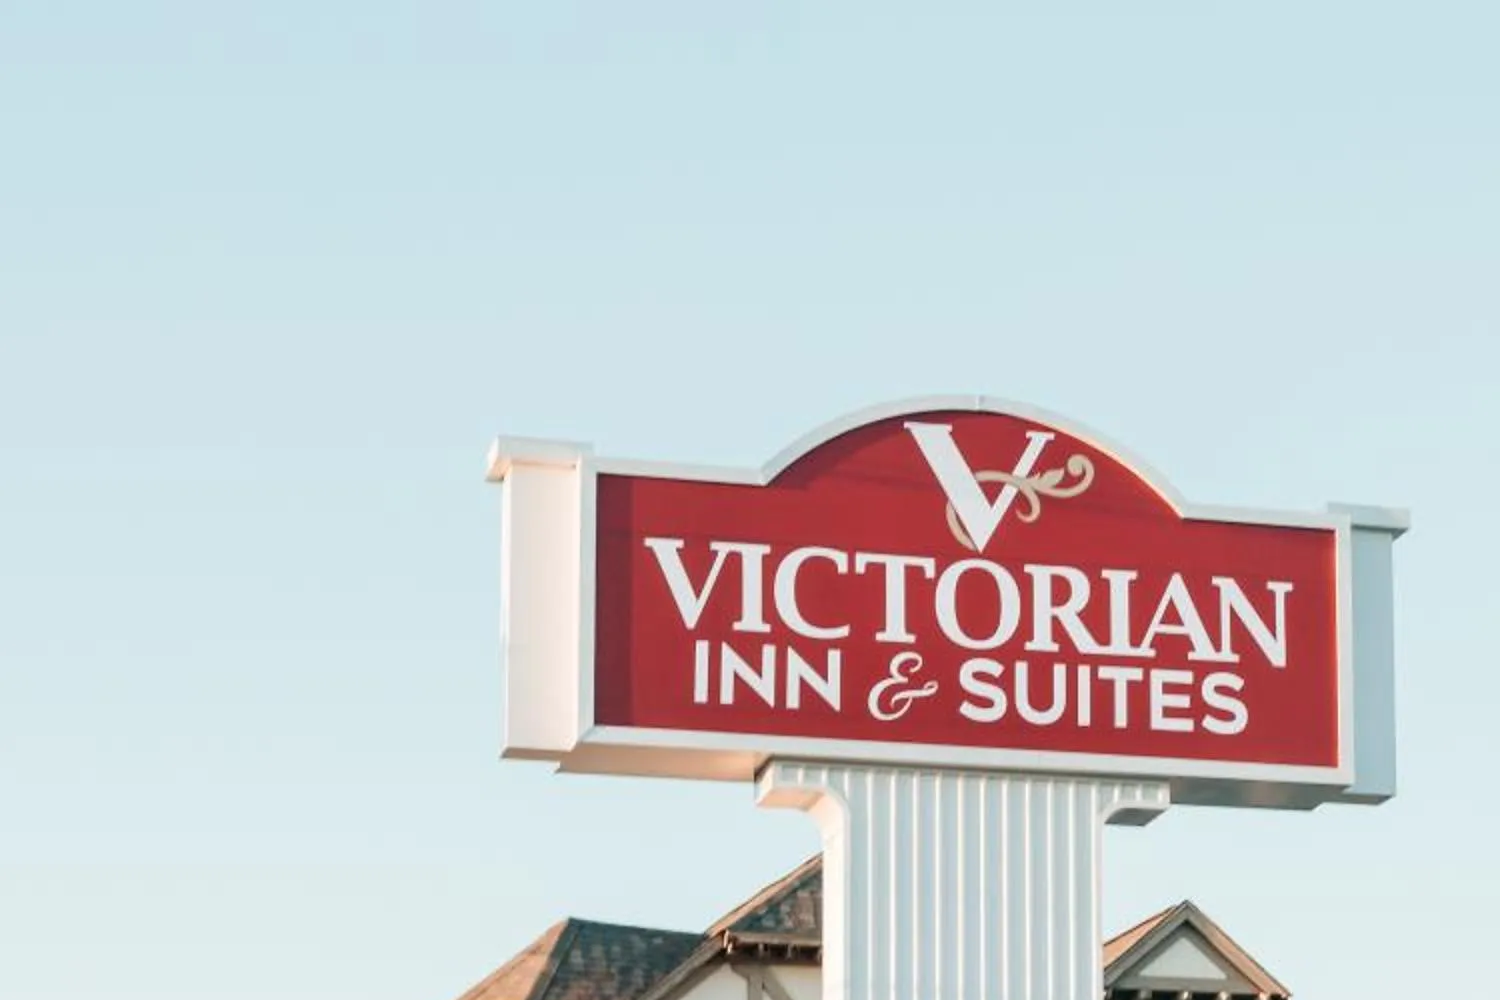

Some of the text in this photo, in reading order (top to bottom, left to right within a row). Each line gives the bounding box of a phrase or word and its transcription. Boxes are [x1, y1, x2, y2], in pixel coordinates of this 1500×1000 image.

[904, 421, 1054, 552] V
[644, 537, 1293, 668] VICTORIAN
[693, 640, 1249, 734] INN & SUITES
